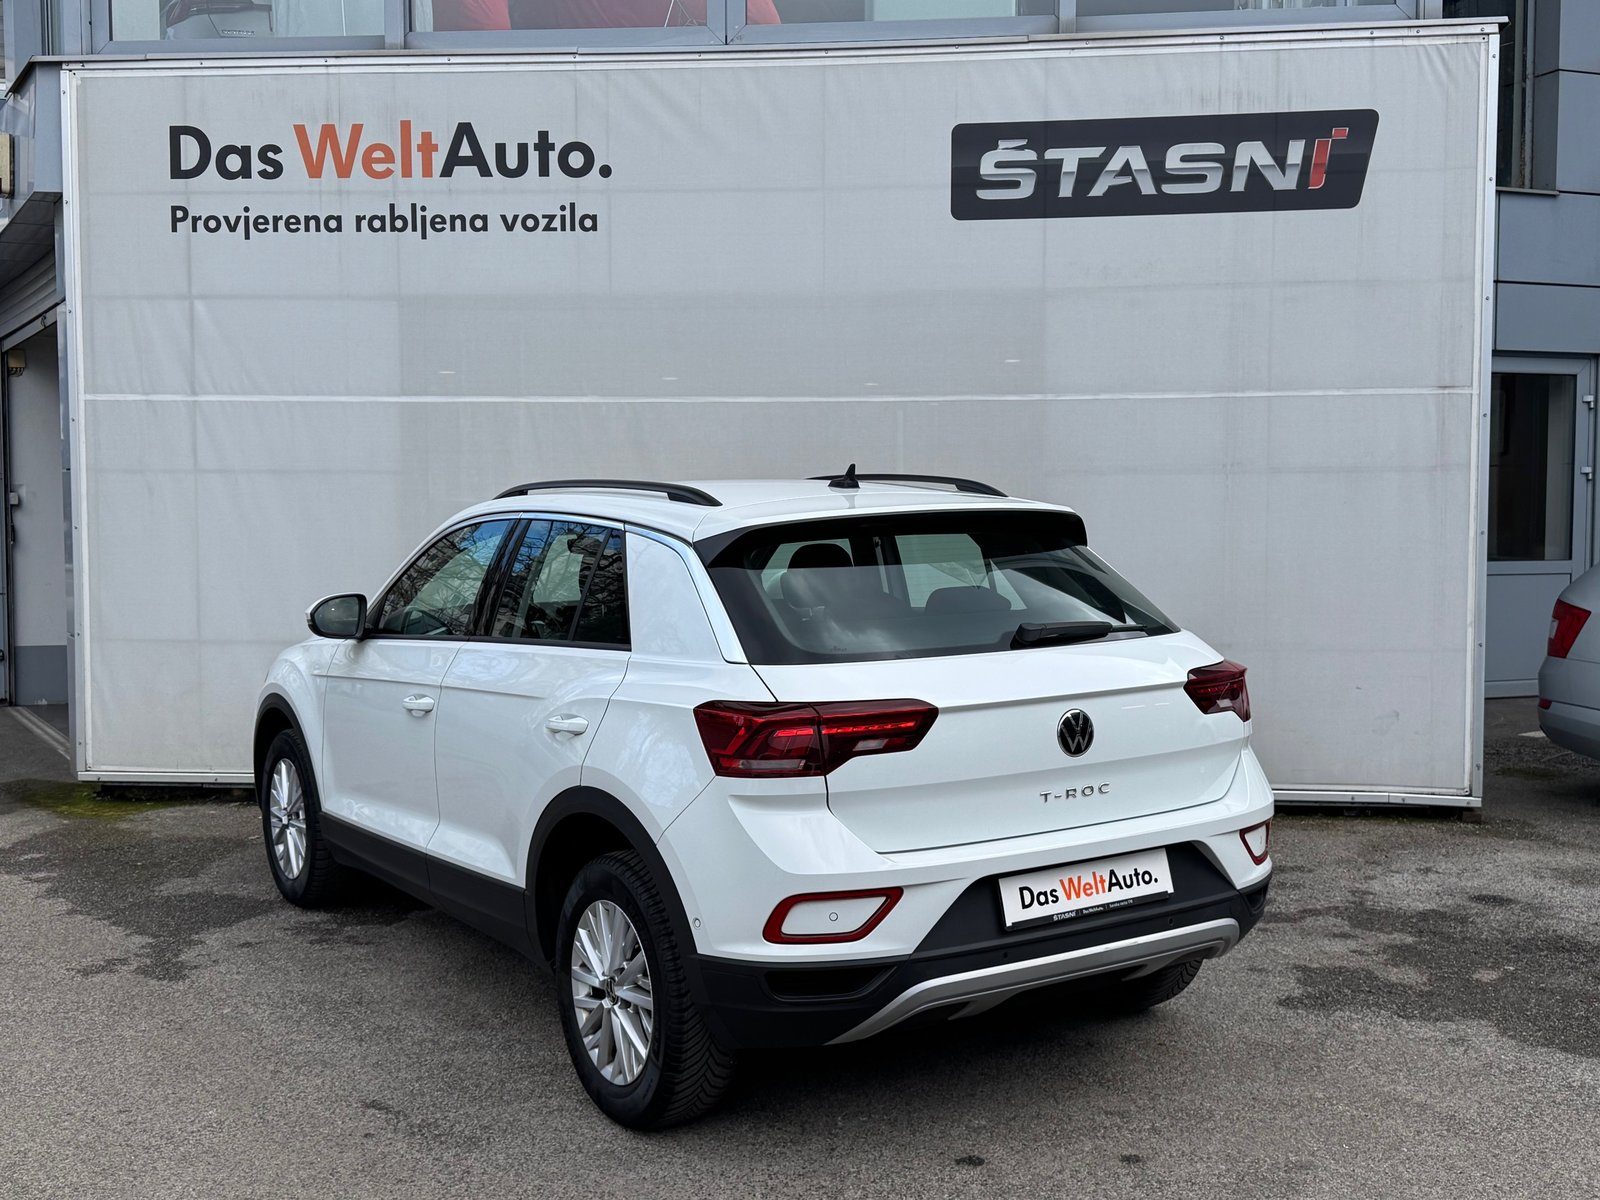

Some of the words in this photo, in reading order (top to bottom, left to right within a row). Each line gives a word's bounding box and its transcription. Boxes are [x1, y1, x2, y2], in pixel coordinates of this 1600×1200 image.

[168, 125, 284, 180] Das
[293, 119, 613, 180] WeltAuto.
[170, 205, 343, 240] Provjerena
[355, 203, 489, 240] rabljena
[500, 202, 598, 233] vozila
[1040, 782, 1110, 803] T-ROC
[1018, 885, 1060, 910] Das
[1059, 867, 1159, 901] WeltAuto.
